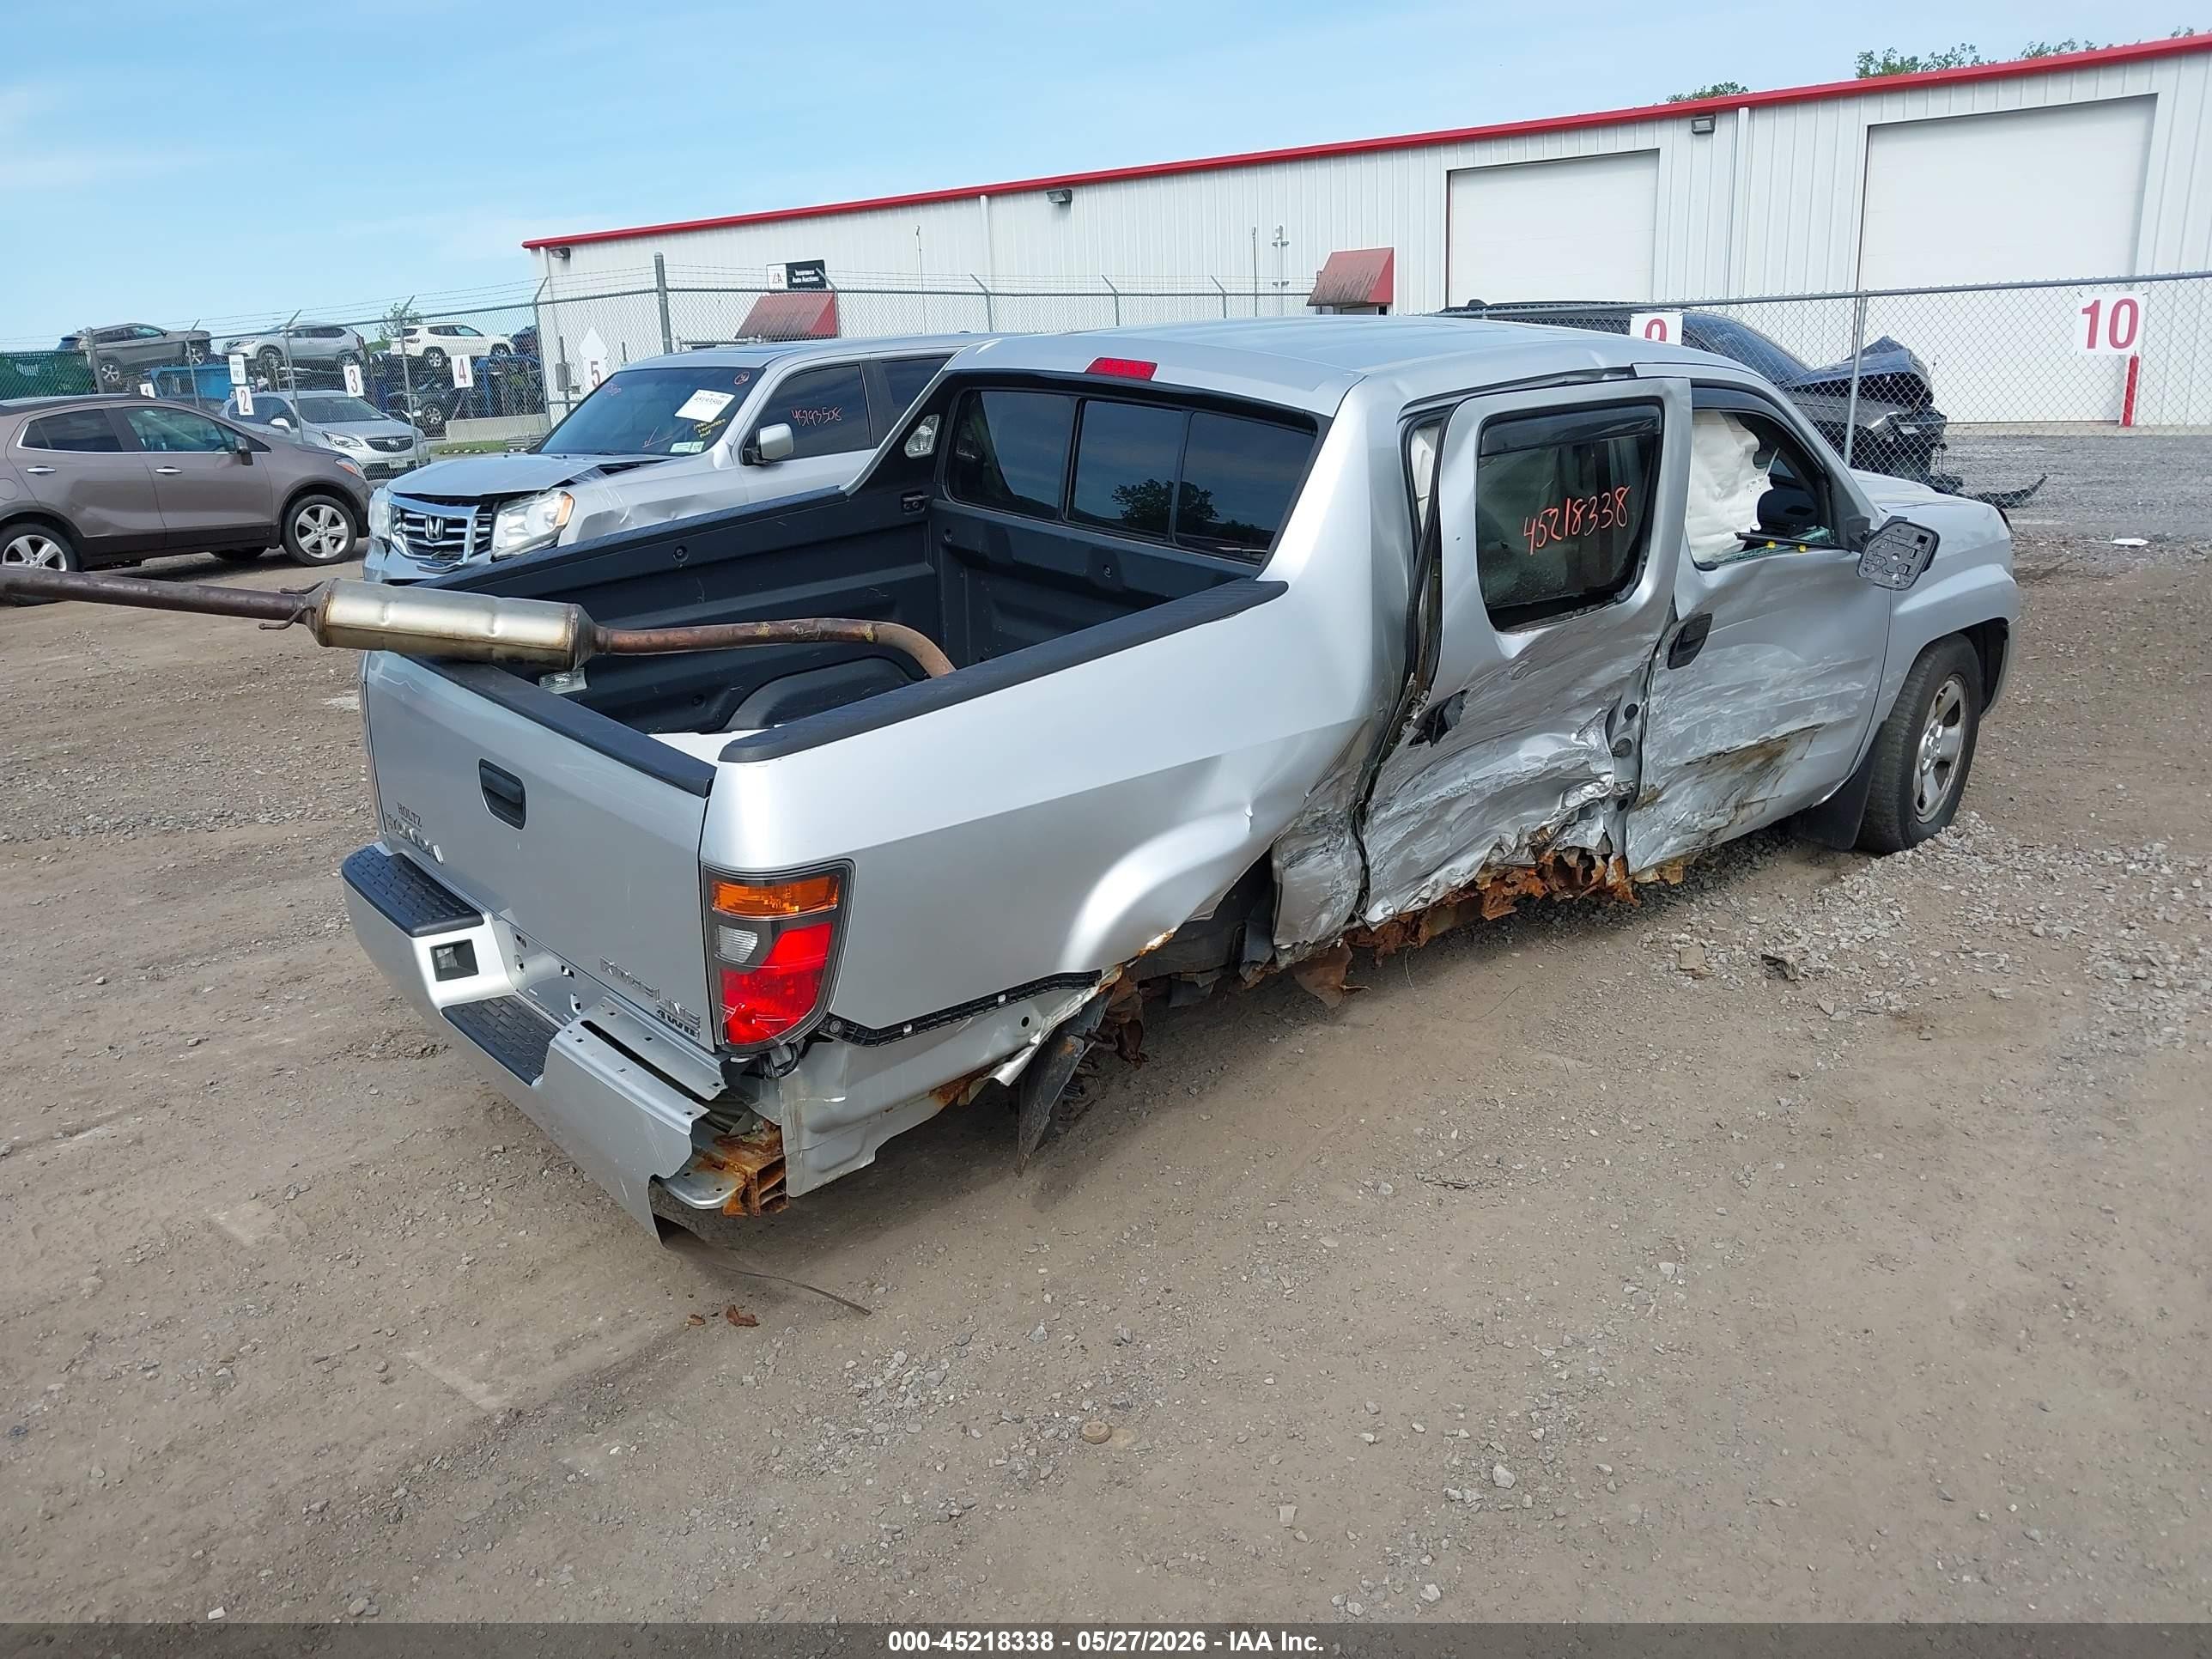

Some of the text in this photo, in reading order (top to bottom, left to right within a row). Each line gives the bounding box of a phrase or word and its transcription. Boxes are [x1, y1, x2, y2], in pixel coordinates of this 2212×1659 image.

[2081, 298, 2139, 349] 10
[349, 368, 358, 392] 3
[459, 358, 468, 384] 4
[590, 361, 601, 387] 5
[240, 390, 250, 412] 2
[1523, 485, 1632, 556] 45218338
[397, 802, 422, 828] HOLTZ
